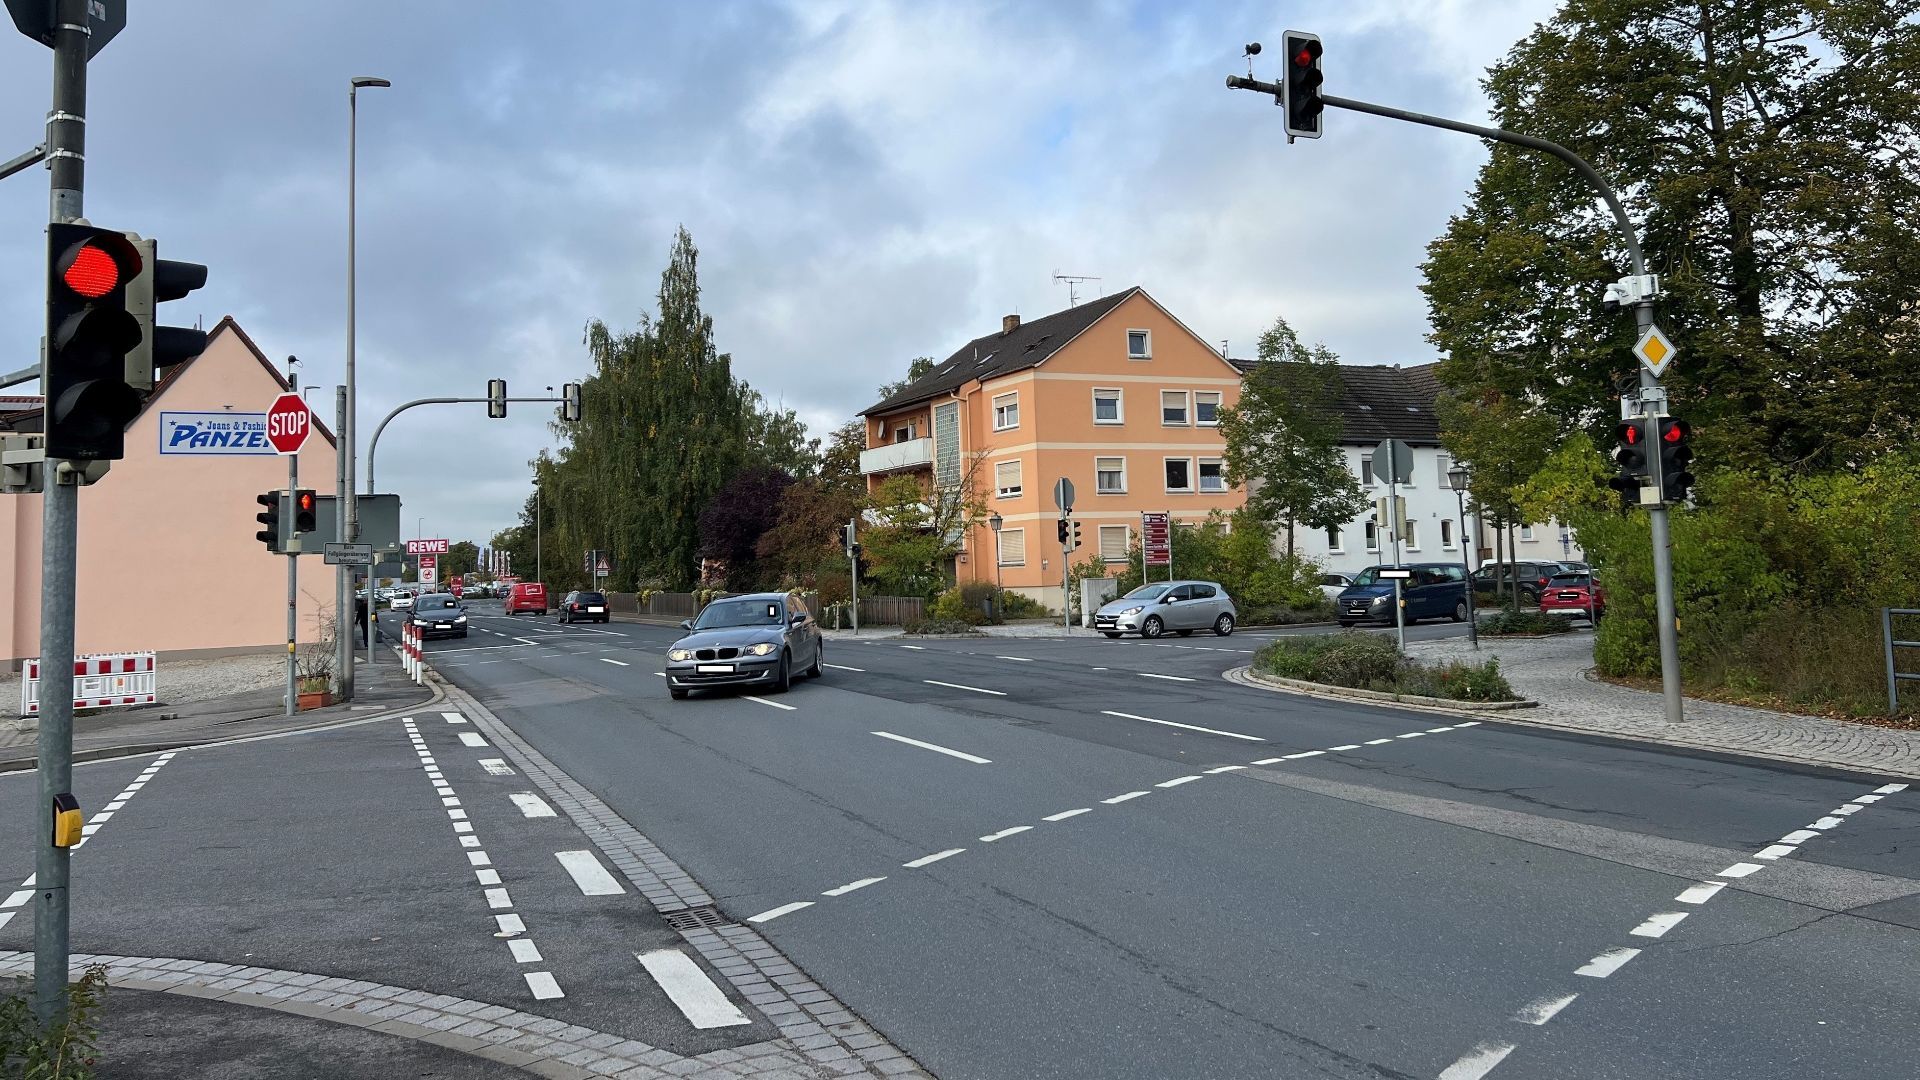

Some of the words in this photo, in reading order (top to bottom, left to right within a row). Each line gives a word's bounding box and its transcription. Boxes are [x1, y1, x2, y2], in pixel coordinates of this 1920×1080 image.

[207, 421, 231, 431] Jeans
[233, 421, 240, 431] &
[270, 411, 306, 437] STOP
[408, 541, 446, 553] REWE
